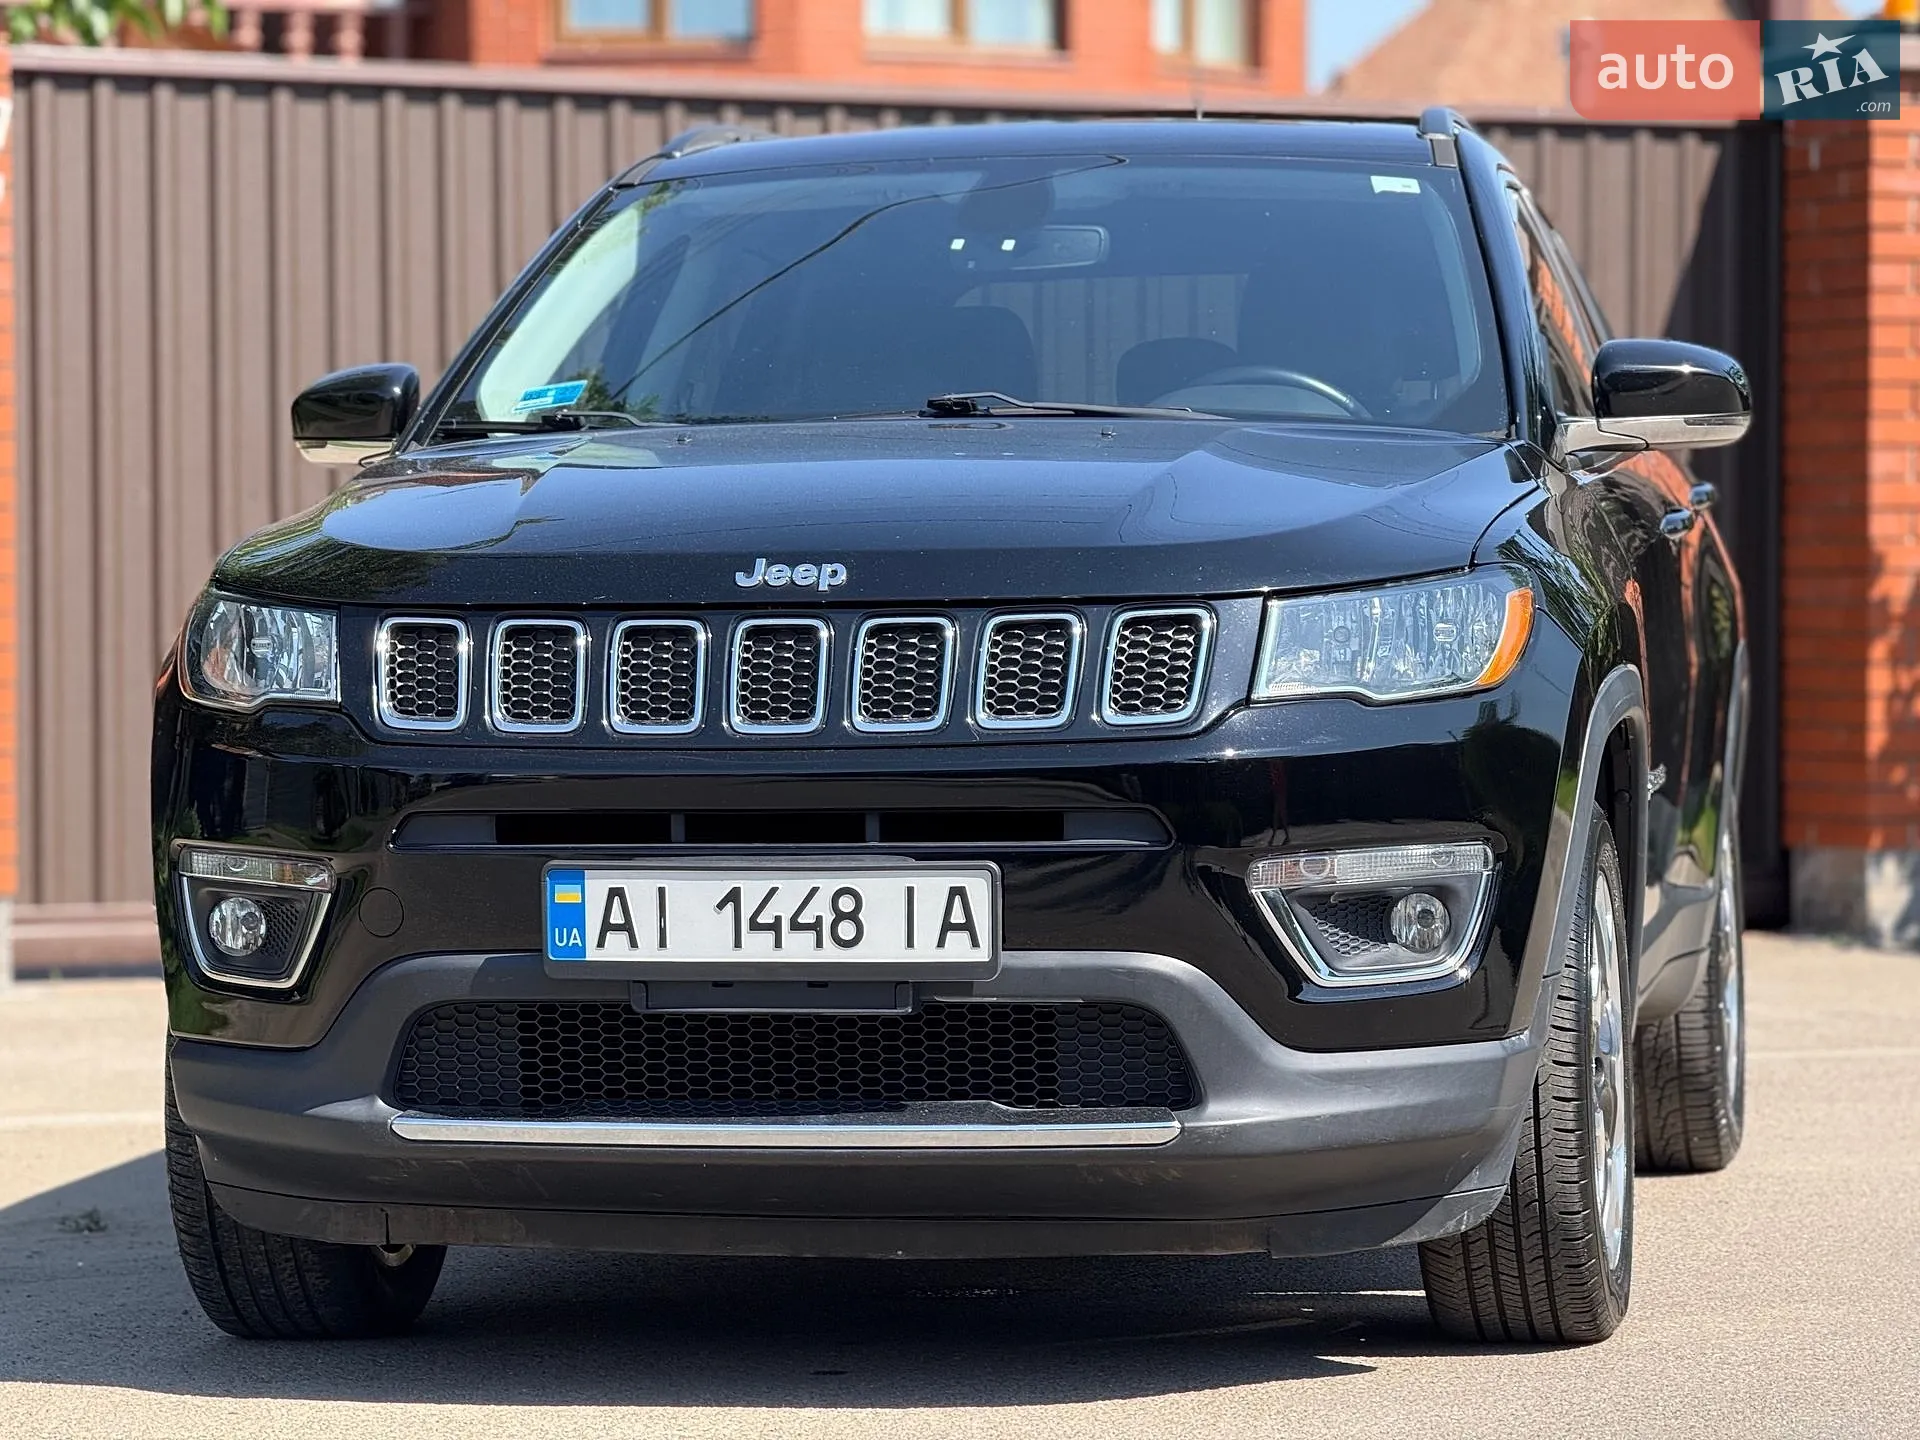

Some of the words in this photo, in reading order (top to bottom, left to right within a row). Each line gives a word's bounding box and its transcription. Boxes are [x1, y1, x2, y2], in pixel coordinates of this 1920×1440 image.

[735, 557, 847, 592] Jeep
[595, 886, 668, 951] AI
[713, 885, 865, 950] 1448
[904, 885, 981, 950] IA
[555, 928, 582, 947] UA
